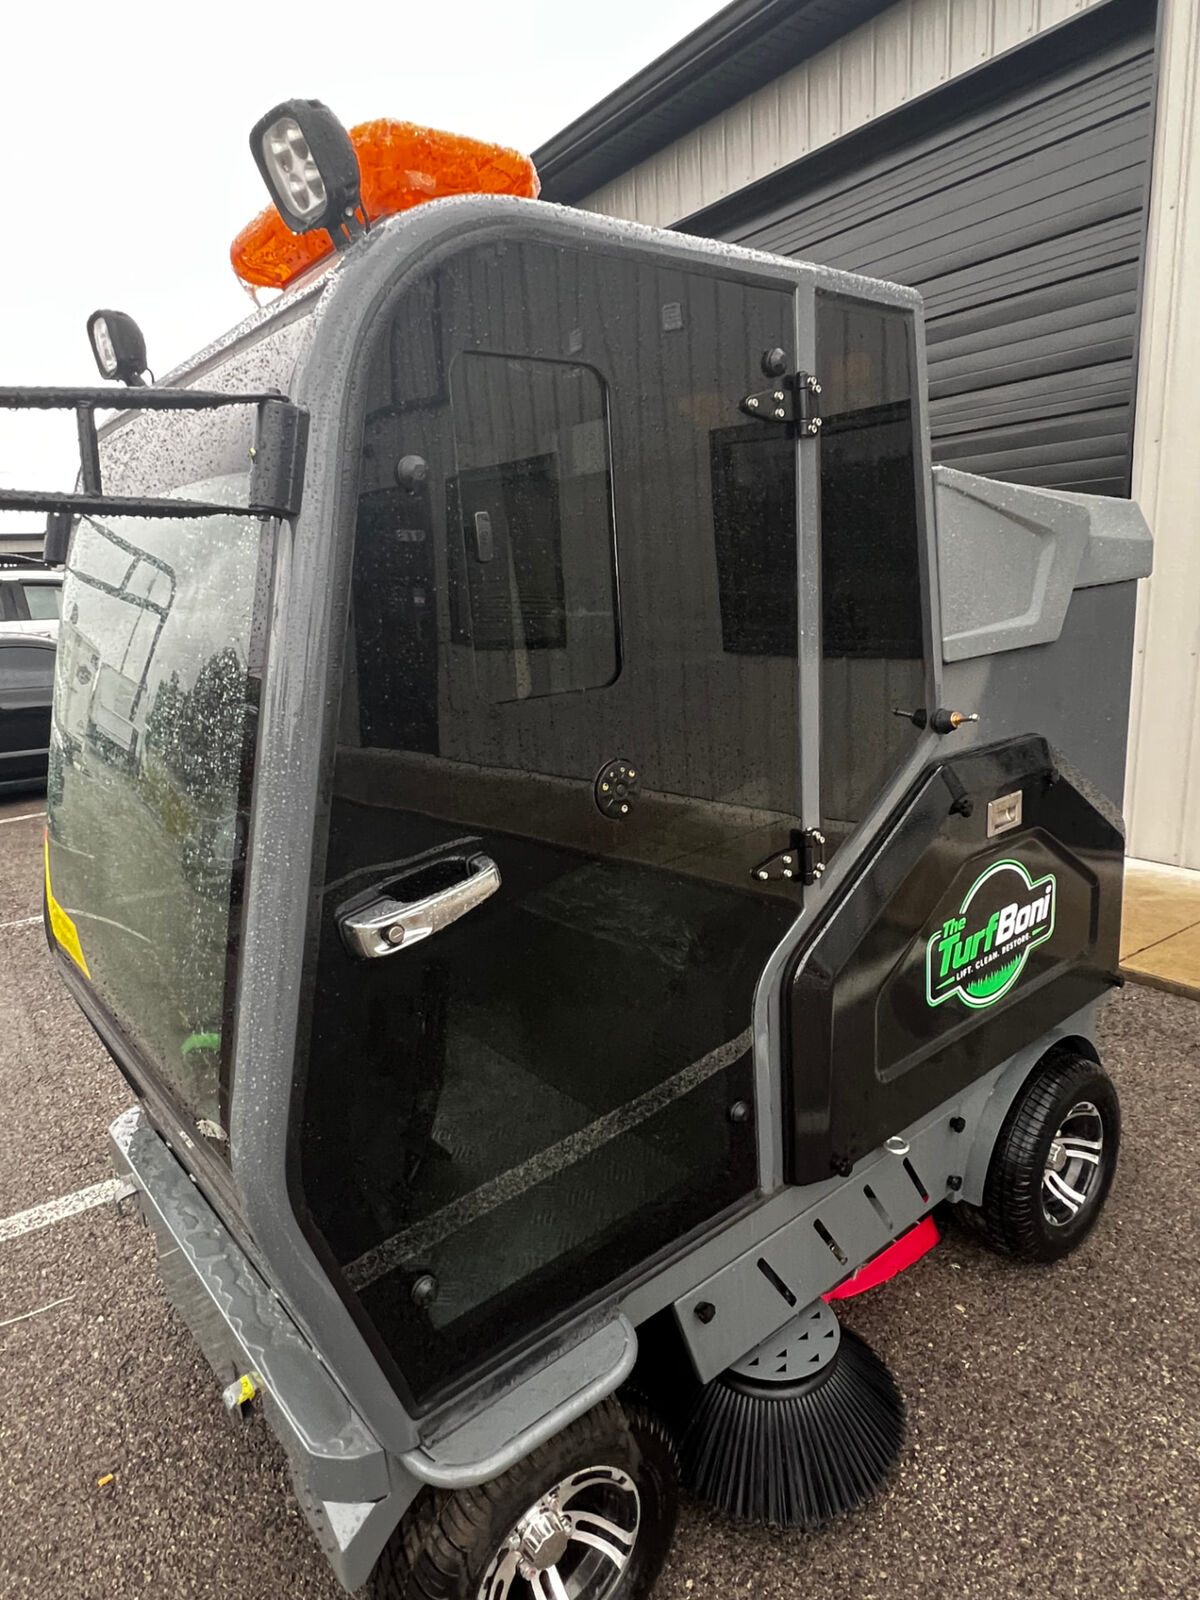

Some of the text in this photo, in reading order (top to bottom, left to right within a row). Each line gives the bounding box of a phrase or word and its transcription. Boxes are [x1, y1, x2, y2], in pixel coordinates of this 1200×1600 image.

[938, 884, 1052, 977] TurfBoni
[943, 916, 966, 938] The
[956, 932, 1031, 981] LIFT. CLEAN. RESTORE.
